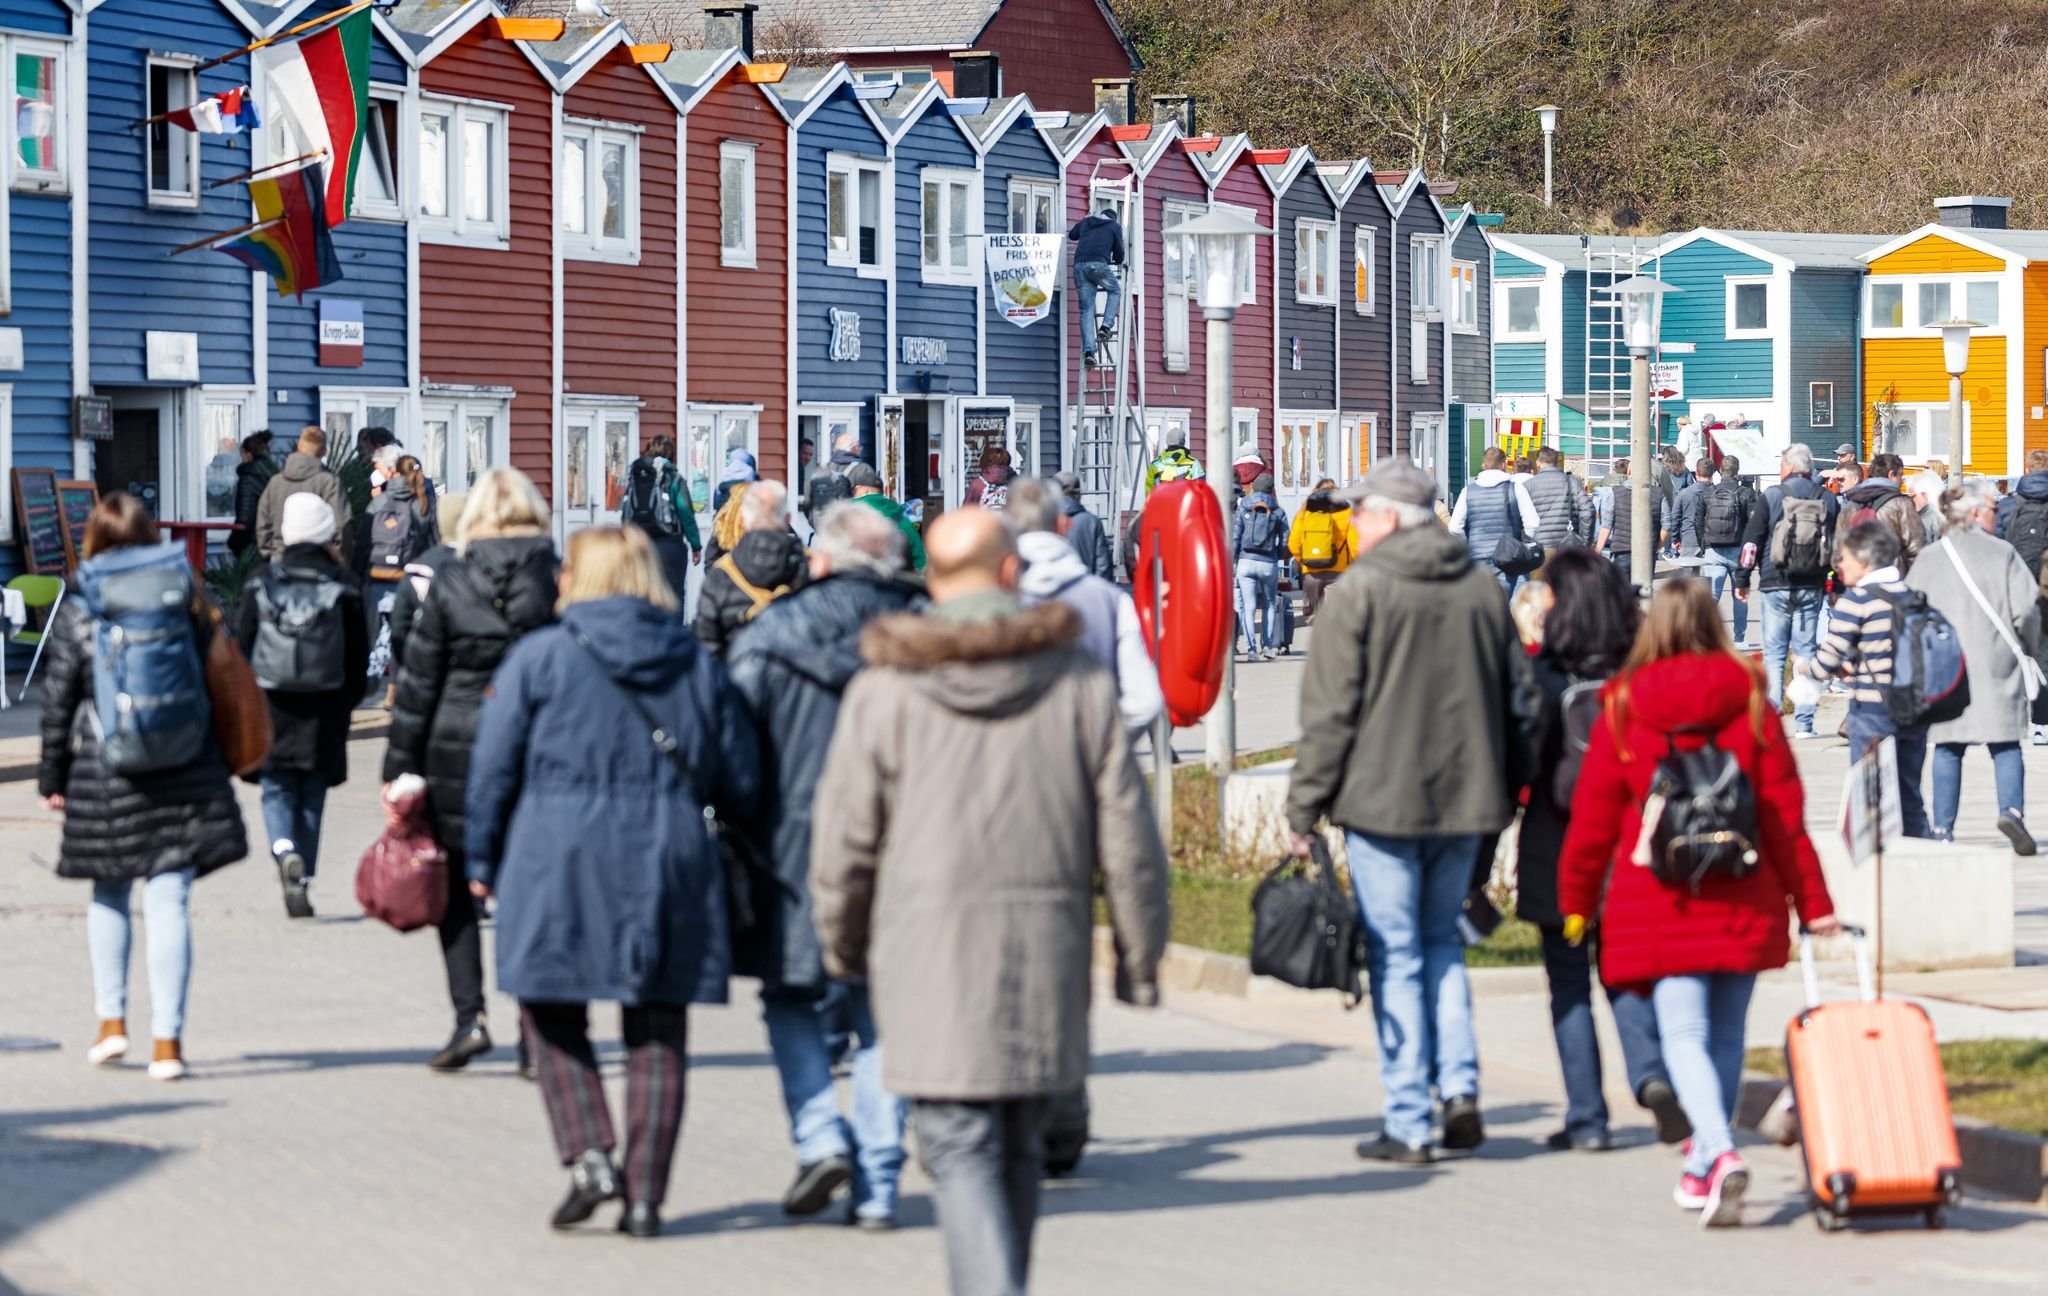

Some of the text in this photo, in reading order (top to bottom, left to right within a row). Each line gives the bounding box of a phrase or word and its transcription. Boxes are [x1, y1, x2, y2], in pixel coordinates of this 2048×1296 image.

[990, 235, 1040, 247] HEISSER
[1006, 249, 1053, 260] FRISCHER
[965, 418, 1005, 431] SPEISEKARTE
